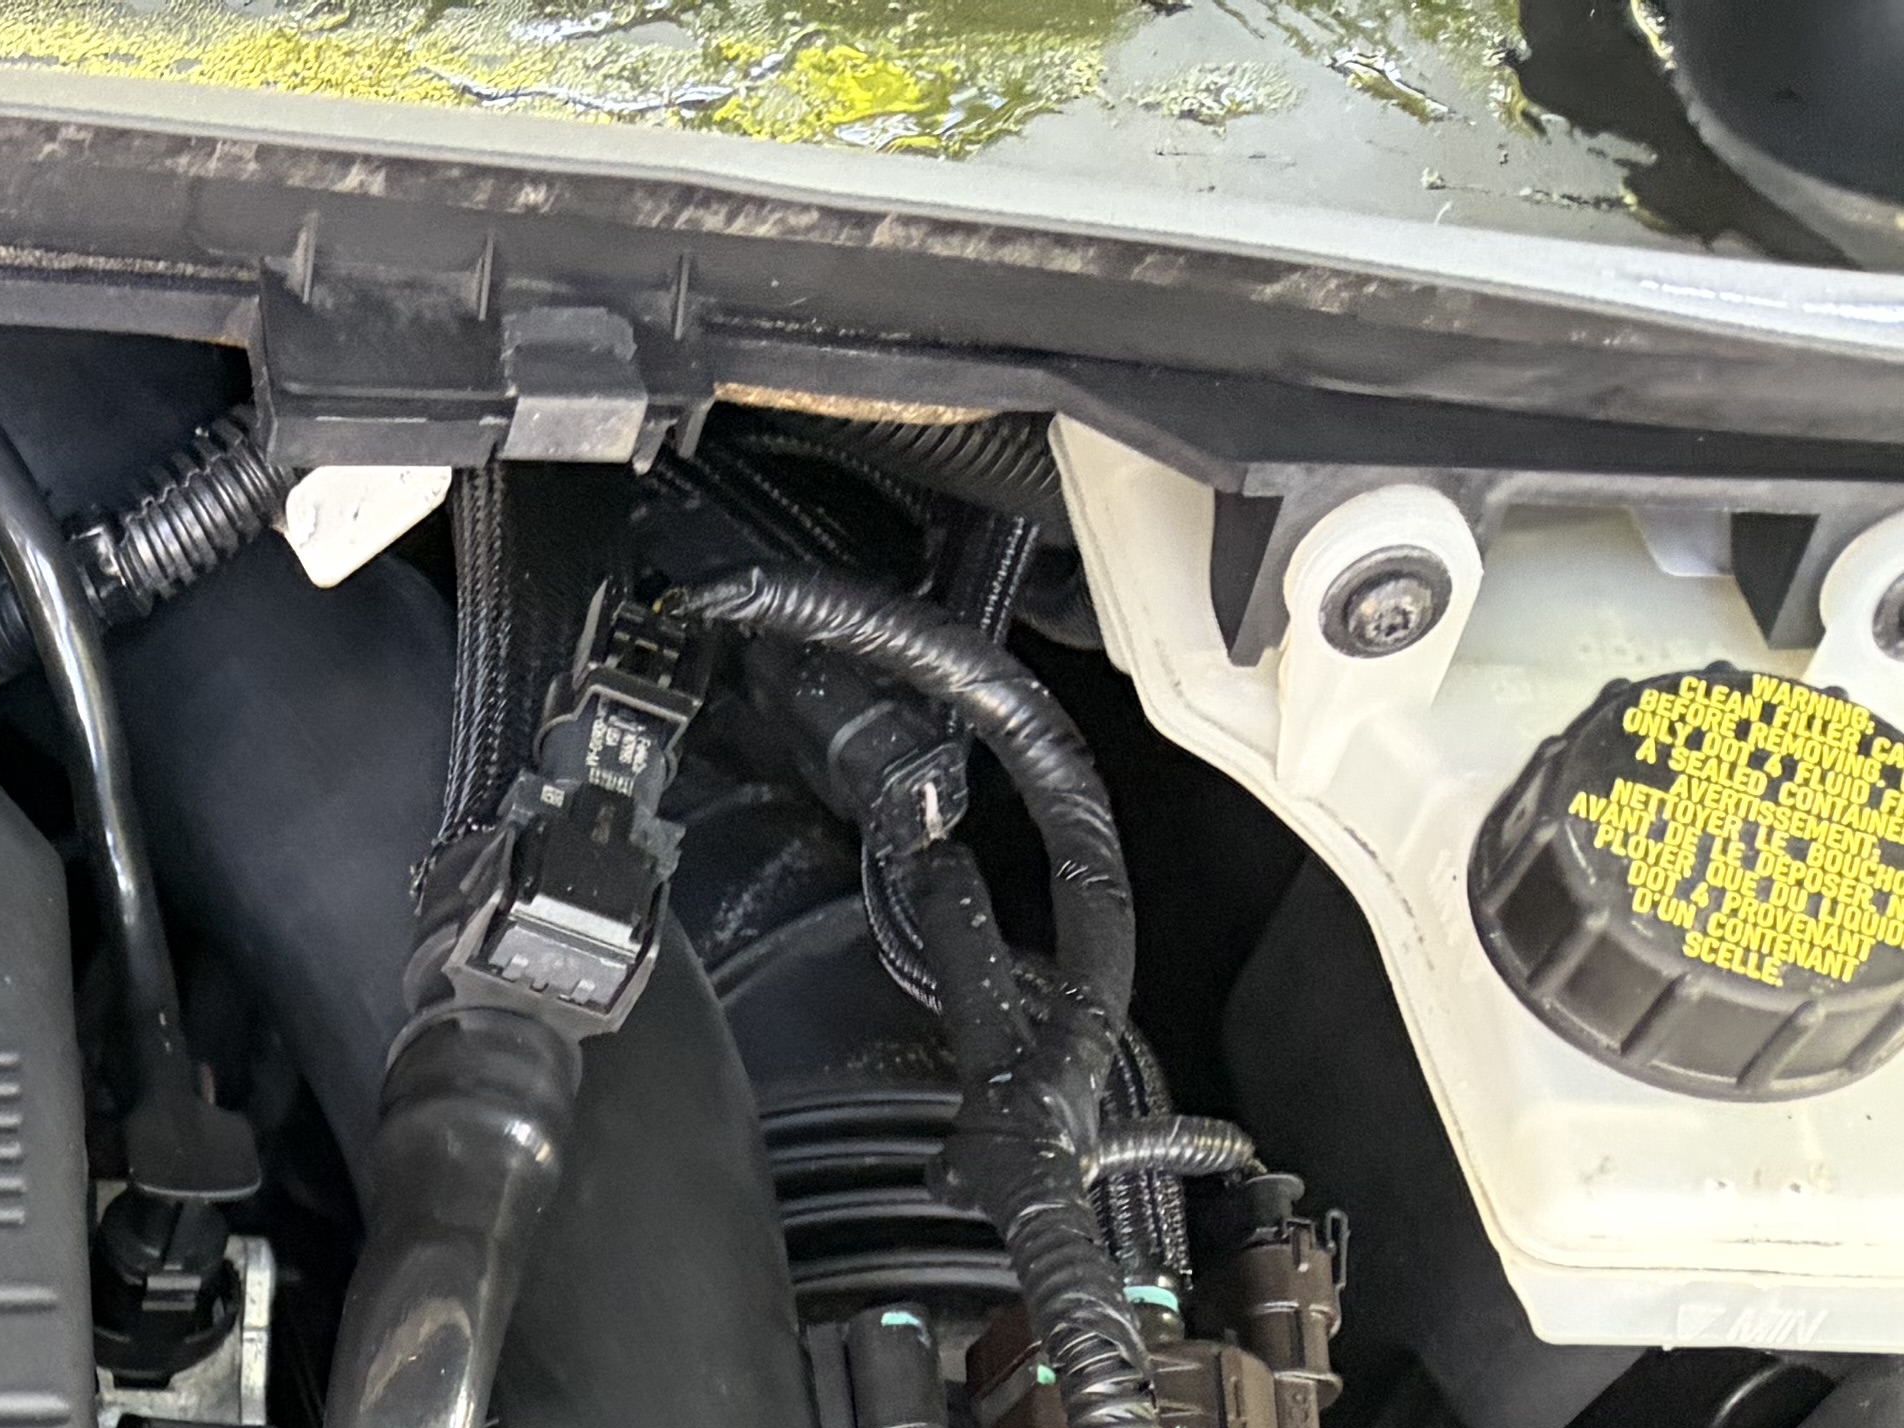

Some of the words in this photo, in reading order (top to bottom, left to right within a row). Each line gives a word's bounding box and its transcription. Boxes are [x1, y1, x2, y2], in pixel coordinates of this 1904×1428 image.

[1639, 688, 1736, 739] BEFORE
[1748, 721, 1886, 788] REMOVING.
[1679, 676, 1763, 722] CLEAN
[1772, 704, 1861, 753] FILLER
[1871, 737, 1904, 768] CA
[1752, 674, 1875, 735] WARNING:
[1623, 706, 1694, 747] ONLY
[1702, 731, 1755, 767] DOT
[1763, 753, 1782, 778] 4
[1794, 761, 1871, 805] FLUID
[1635, 738, 1656, 765] A
[1667, 746, 1768, 797] SEALED
[1778, 781, 1904, 844] CONTAINE
[1568, 791, 1651, 838] AVANT
[1664, 820, 1698, 853] DE
[1710, 837, 1745, 868] LE
[1610, 777, 1742, 840] NETTOYER
[1755, 826, 1790, 856] LE
[1806, 841, 1904, 895] BOUCHO
[1594, 823, 1695, 878] PLOYER
[1706, 860, 1760, 899] QUE
[1769, 880, 1808, 912] DU
[1818, 897, 1904, 949] LIQUID
[1627, 861, 1682, 896] DOT
[1691, 882, 1709, 908] 4
[1721, 891, 1876, 962] PROVENANT
[1706, 912, 1859, 982] CONTENANT
